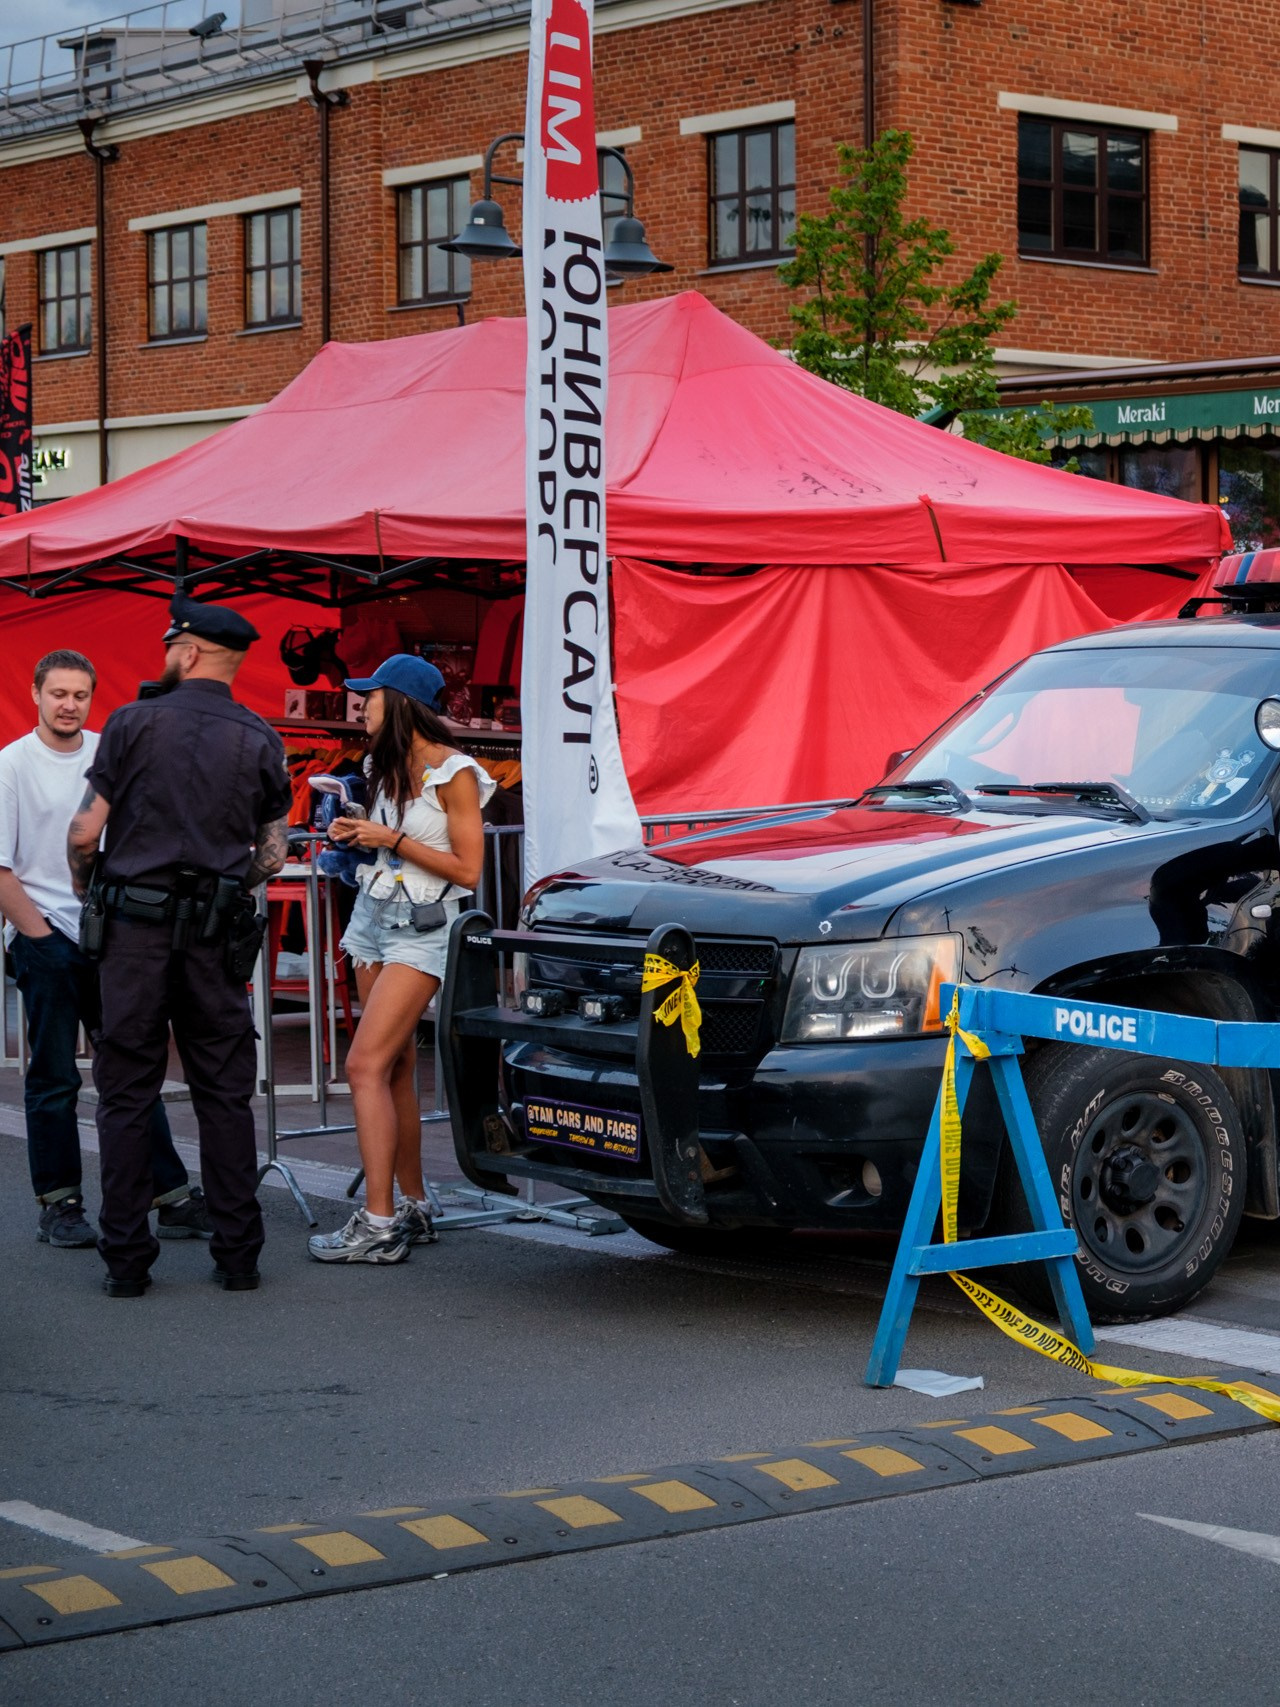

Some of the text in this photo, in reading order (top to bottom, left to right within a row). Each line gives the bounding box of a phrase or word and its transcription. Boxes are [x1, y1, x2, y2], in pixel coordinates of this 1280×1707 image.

[1117, 402, 1166, 424] Meraki
[562, 231, 601, 744] ЮНИВЕРСАЛ
[466, 935, 492, 945] POLICE
[1056, 1007, 1137, 1043] POLICE
[527, 1104, 637, 1141] @TAM_CARS_AND_FACES
[1160, 1069, 1233, 1278] BRIDGESTONE
[1060, 1163, 1130, 1294] DUEER
[1017, 1322, 1040, 1339] DO
[1034, 1331, 1063, 1355] NOT
